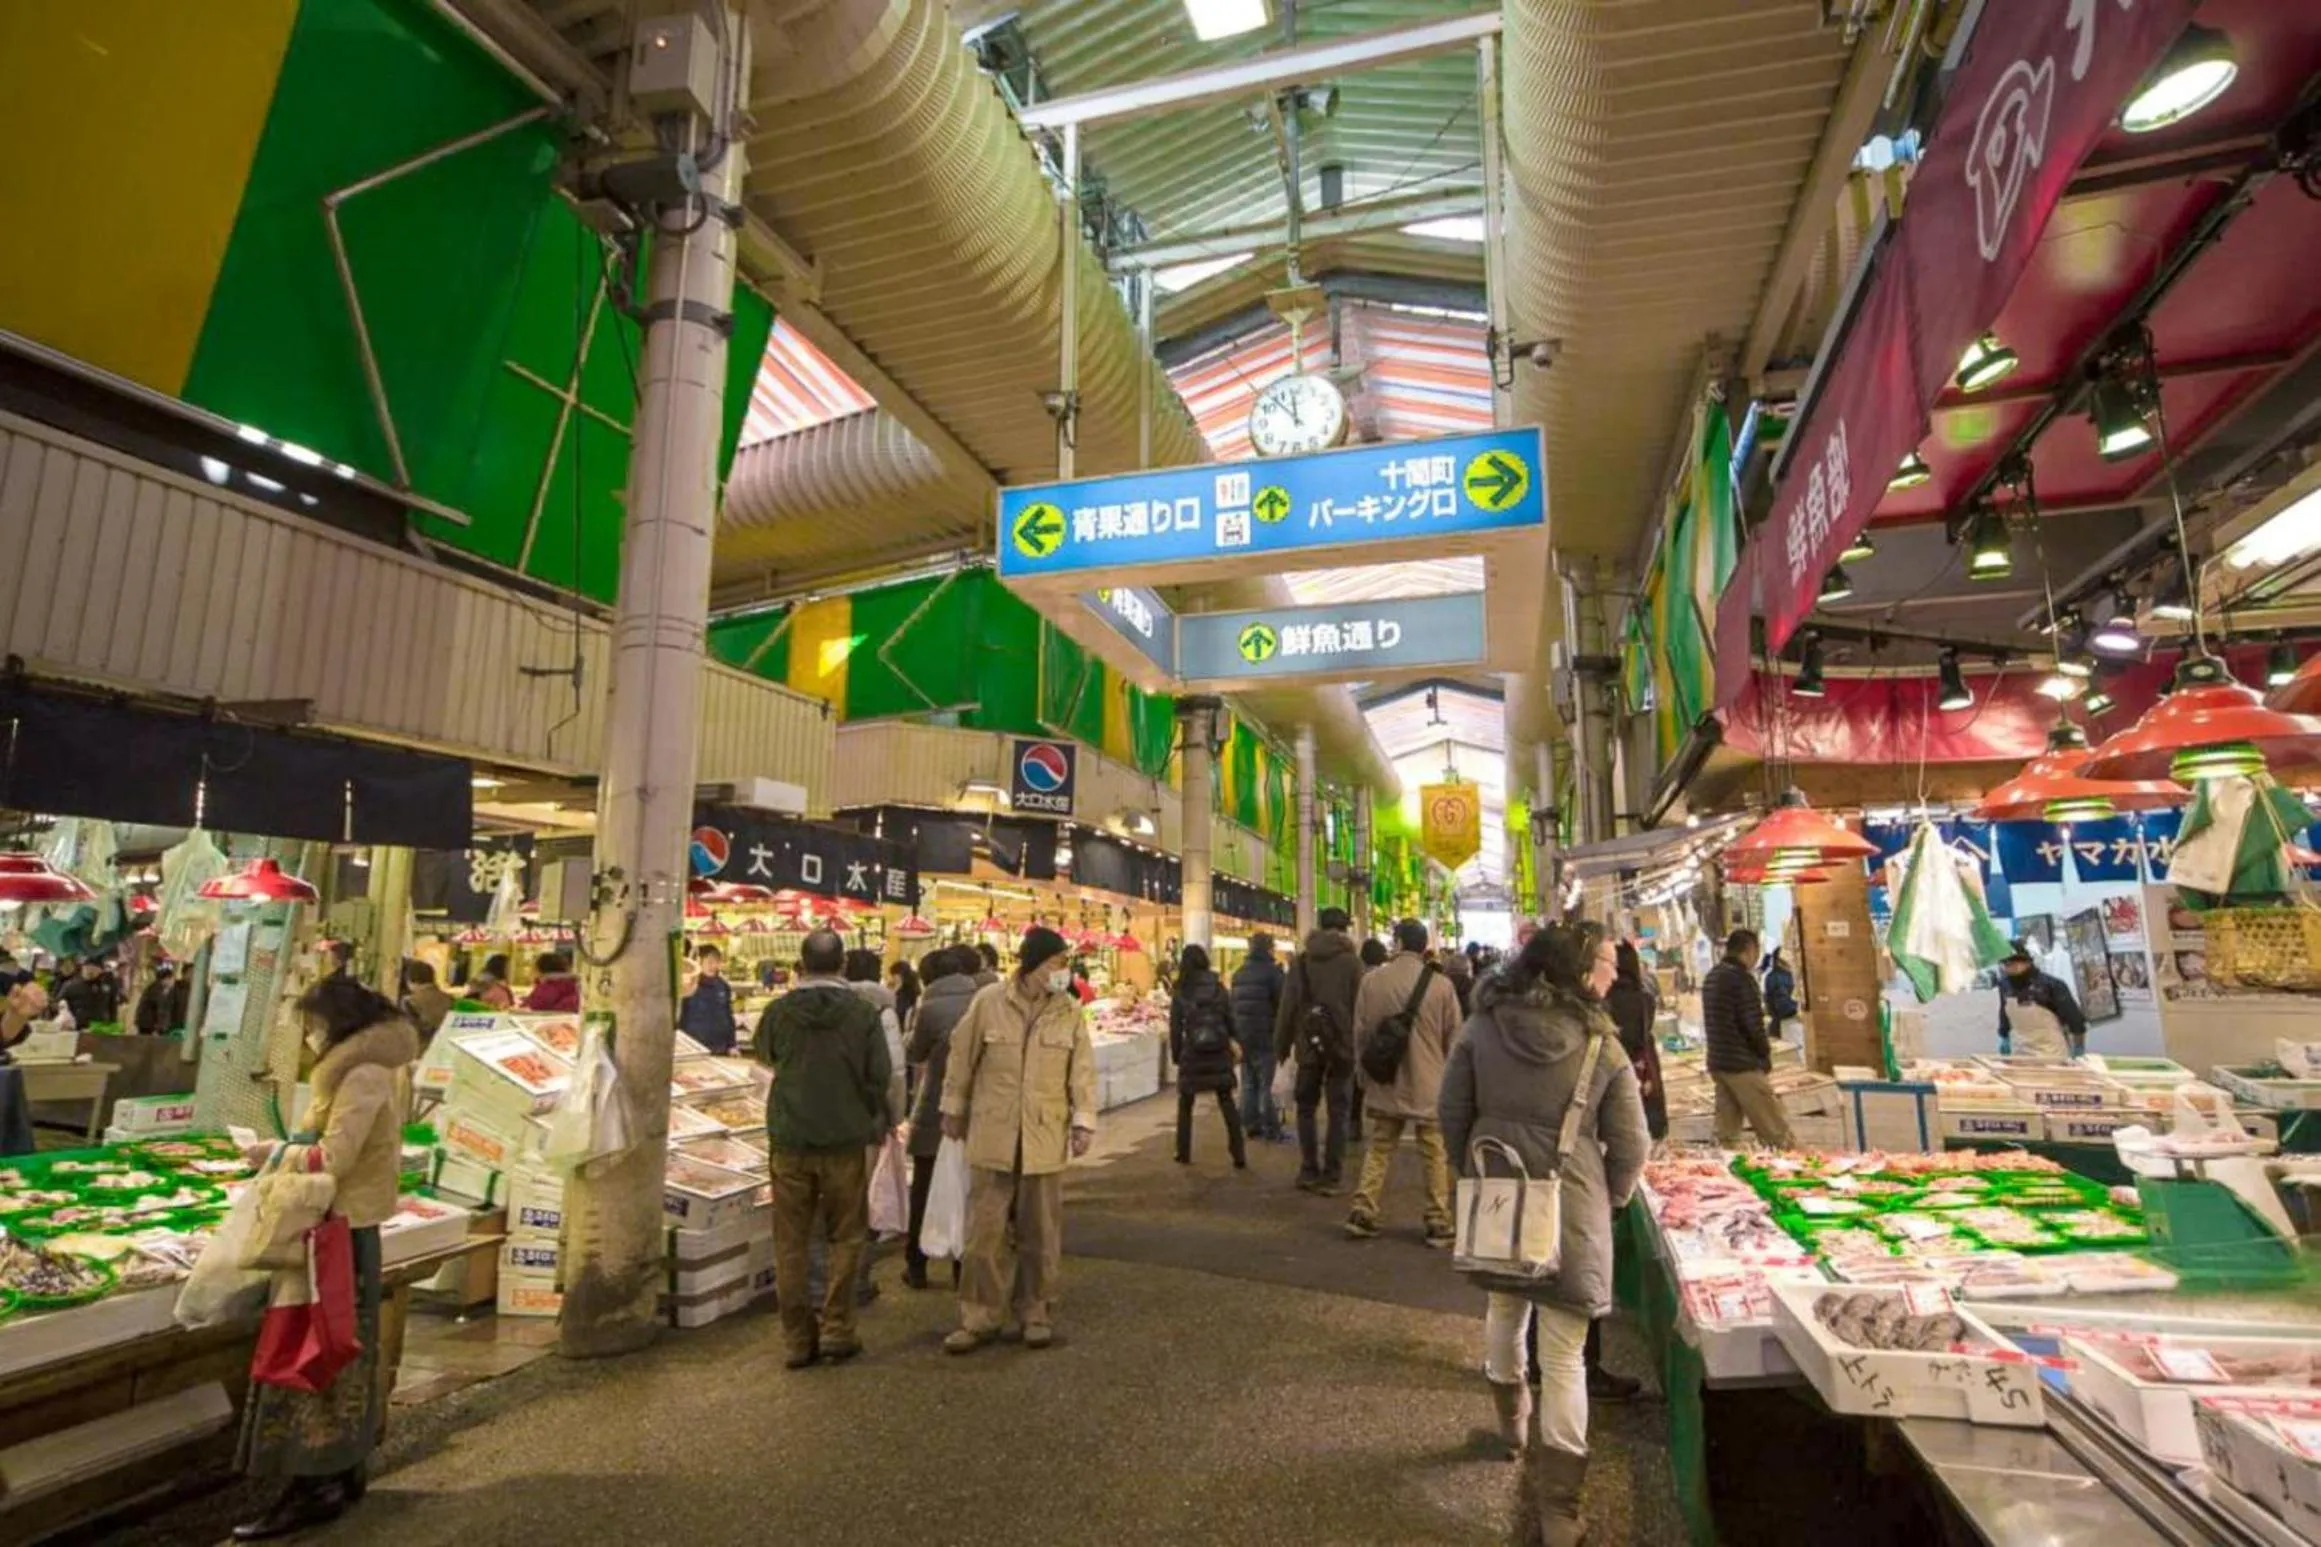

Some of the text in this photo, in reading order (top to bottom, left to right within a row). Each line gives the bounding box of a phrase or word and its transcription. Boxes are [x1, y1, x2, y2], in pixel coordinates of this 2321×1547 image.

[1379, 455, 1457, 491] 十間町
[1072, 496, 1200, 544] 青果通り口
[1307, 487, 1458, 530] パーキング口
[1280, 618, 1401, 657] 鮮魚通り
[746, 842, 908, 899] 大口水産
